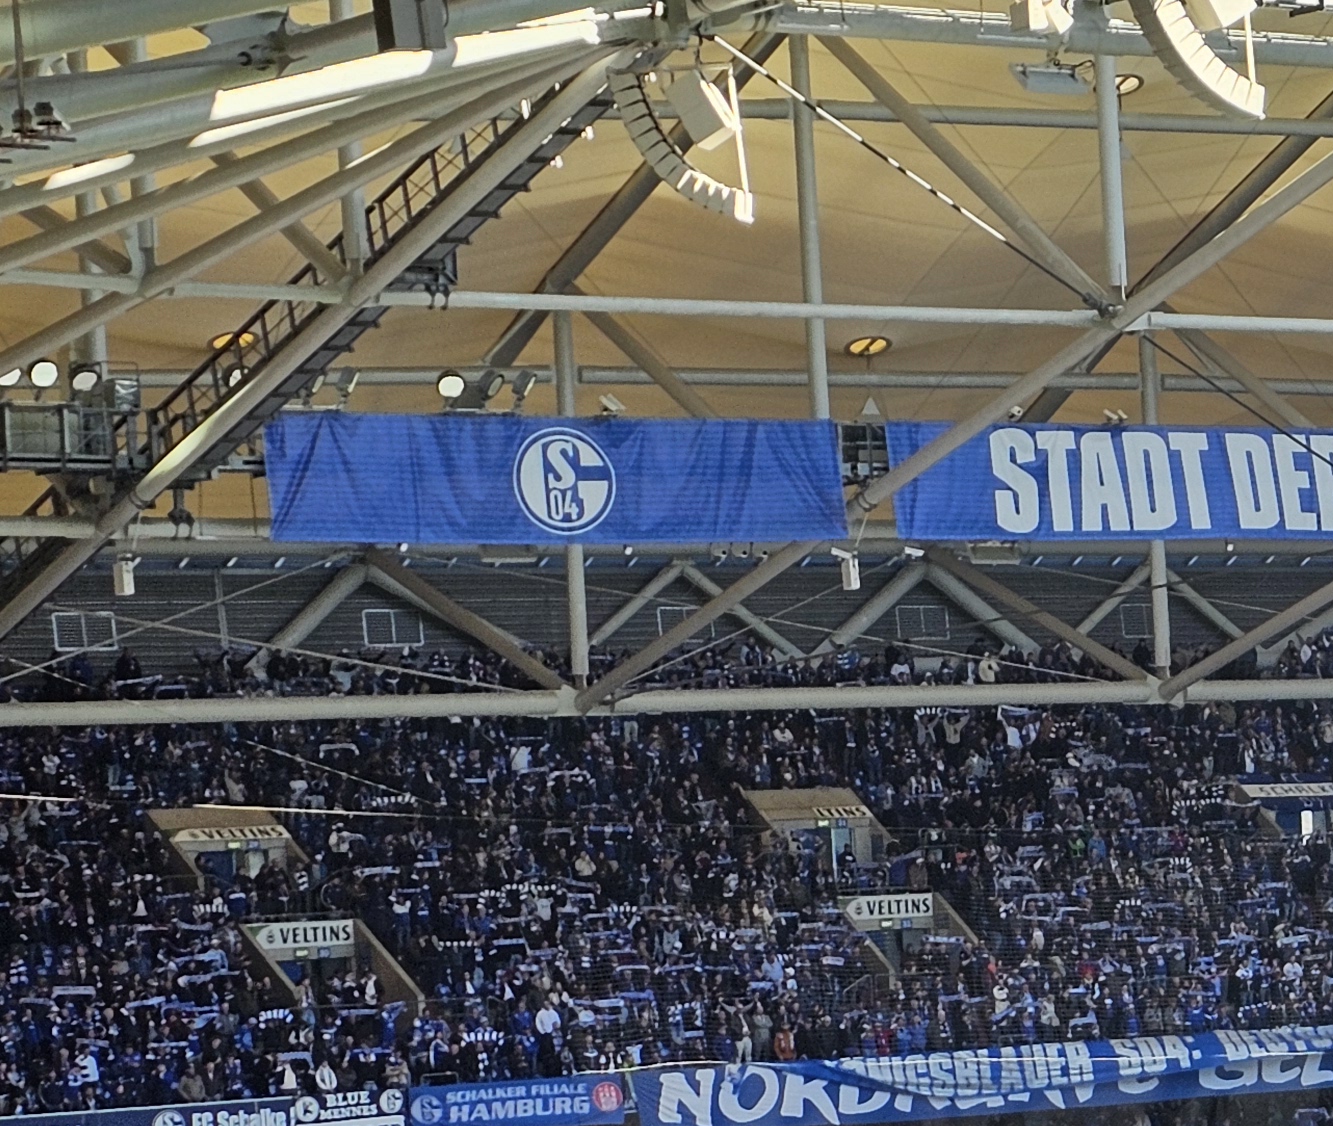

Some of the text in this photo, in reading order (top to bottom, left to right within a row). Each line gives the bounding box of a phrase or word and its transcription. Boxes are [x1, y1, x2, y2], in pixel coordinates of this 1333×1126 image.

[988, 427, 1213, 534] STADT
[816, 807, 867, 817] LTINS
[200, 826, 284, 840] VELTINS
[866, 898, 931, 916] VELTINS
[280, 925, 351, 944] VELTINS
[531, 1083, 587, 1097] FILIALE
[326, 1091, 370, 1108] BLUE
[449, 1096, 591, 1124] HAMBURG
